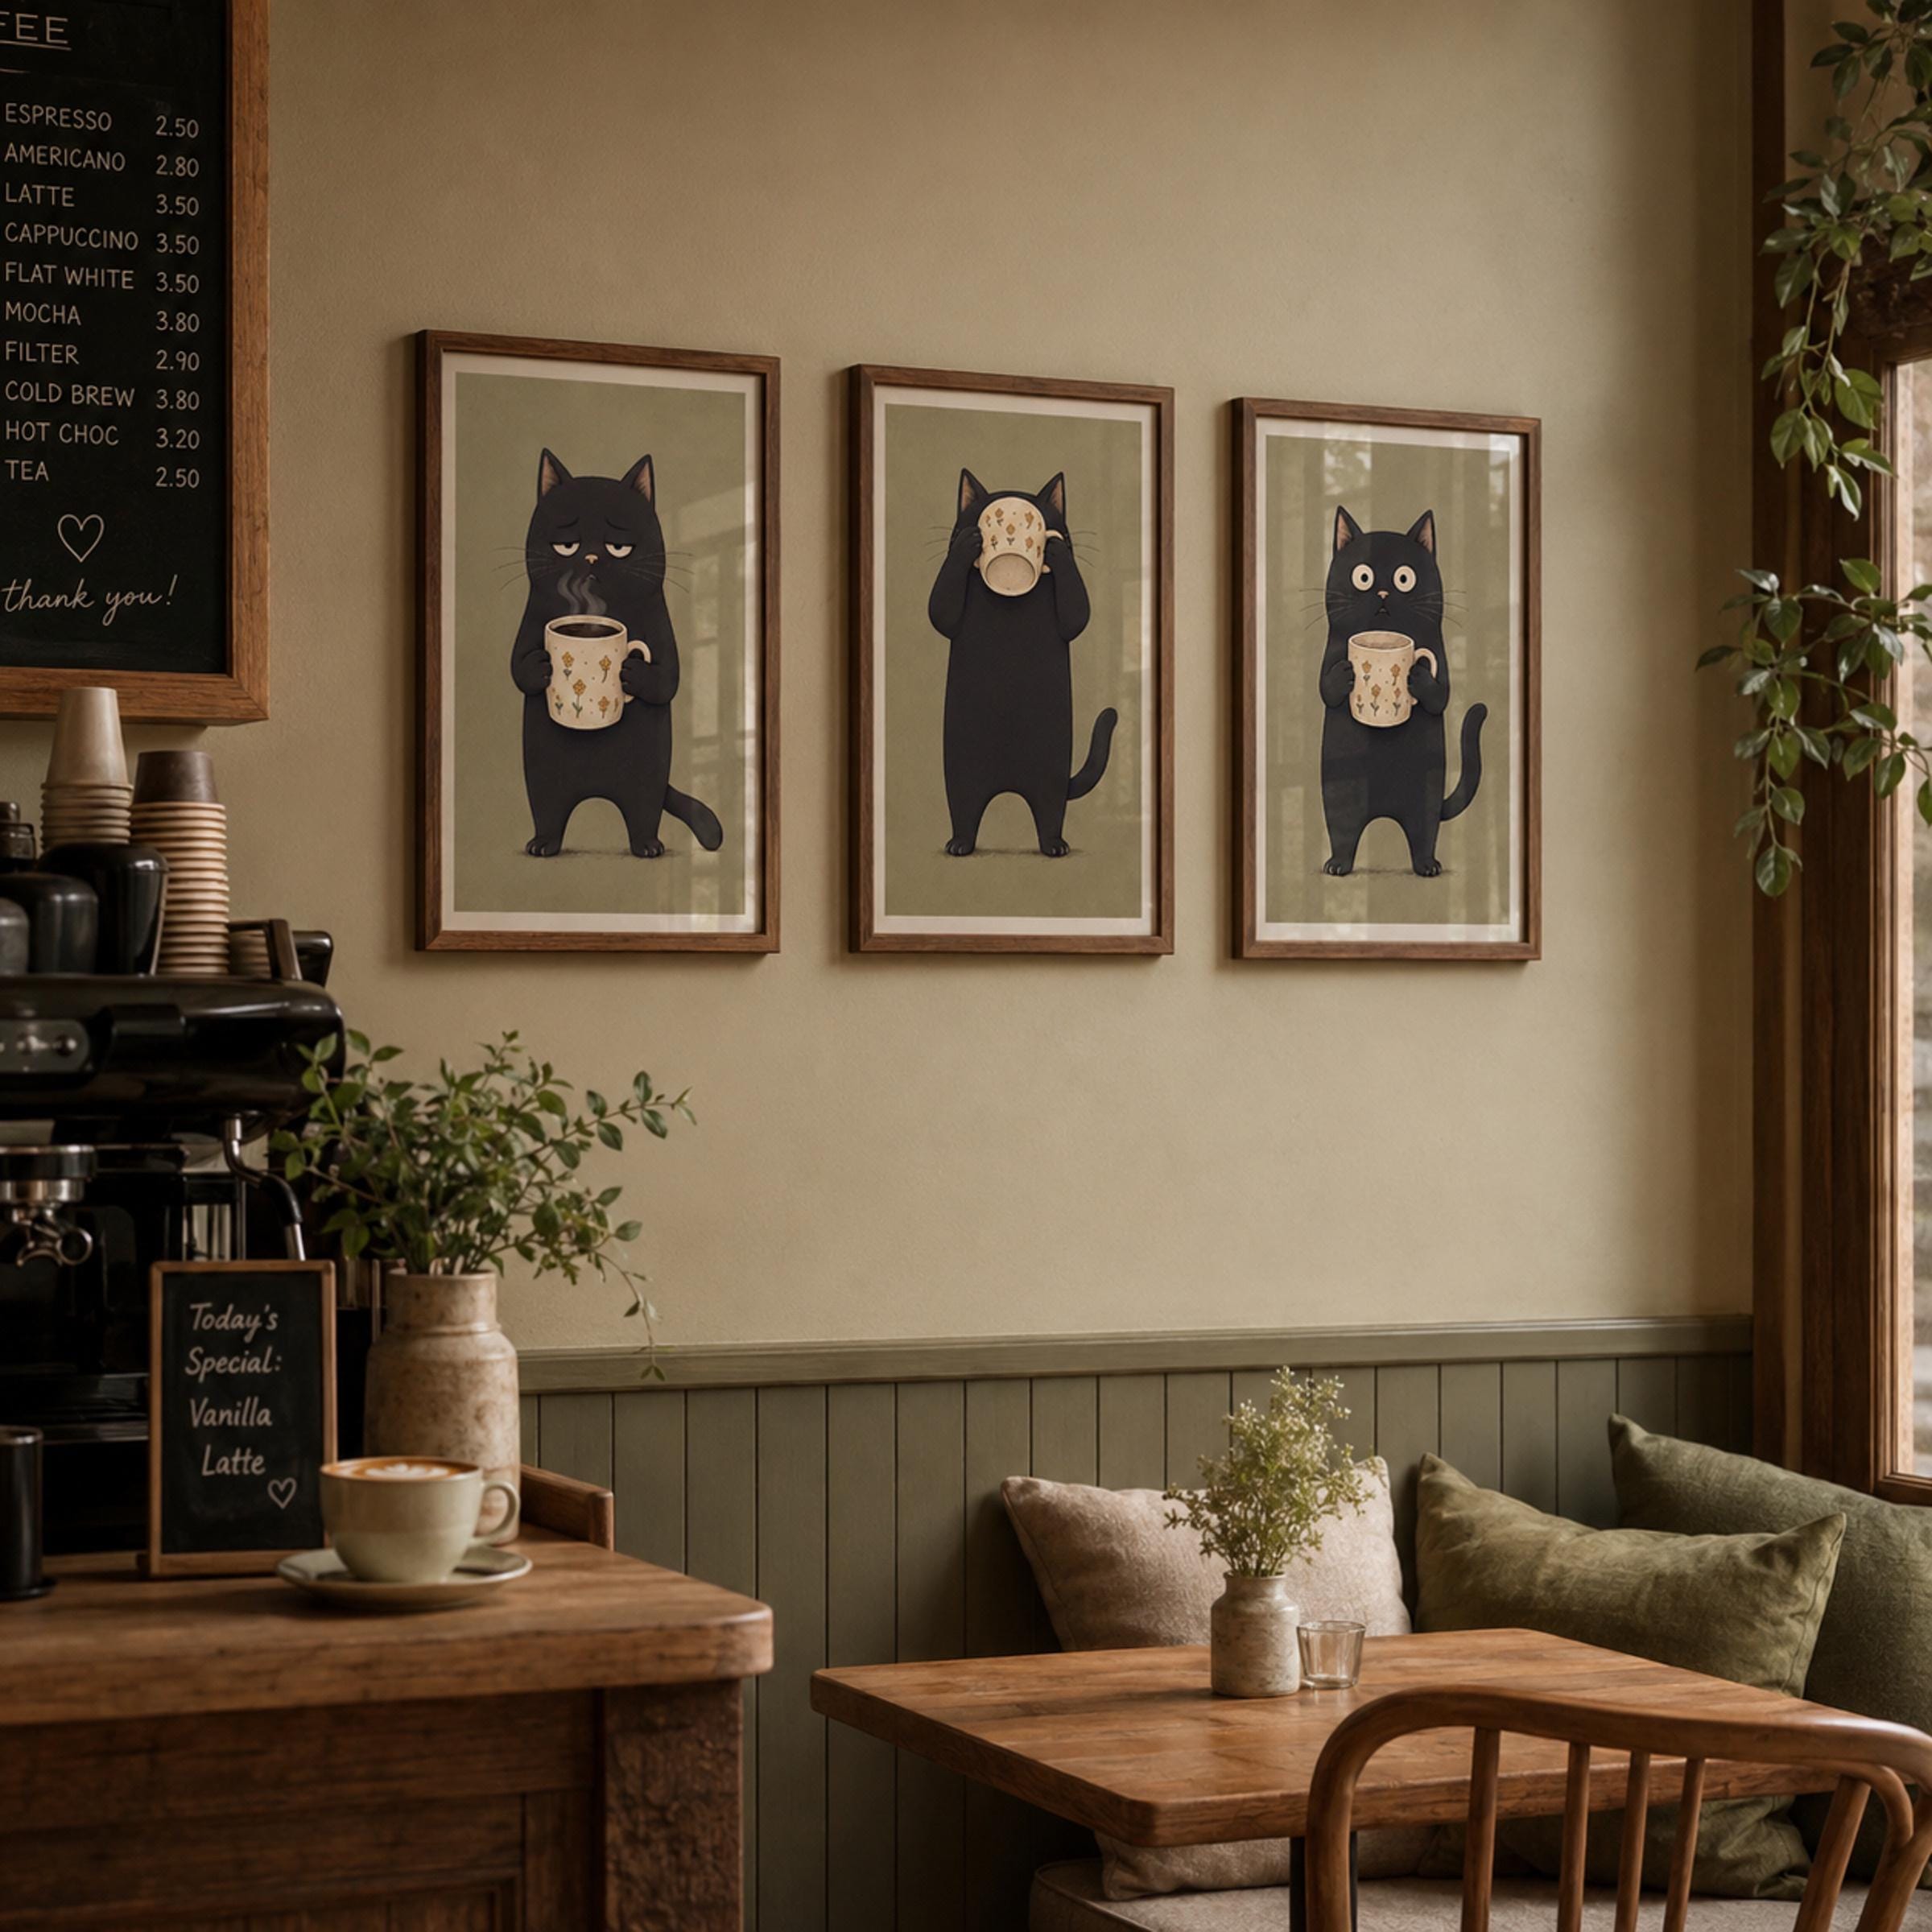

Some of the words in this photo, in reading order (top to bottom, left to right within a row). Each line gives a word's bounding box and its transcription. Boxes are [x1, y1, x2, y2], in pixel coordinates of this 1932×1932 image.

[6, 102, 112, 131] ESPRESSO
[155, 115, 199, 138] 2.50
[4, 142, 126, 171] AMERICANO
[156, 155, 199, 177] 2.80
[6, 183, 74, 207] LATTE
[156, 193, 199, 217] 3.50
[5, 222, 138, 250] CAPPUCCINO
[157, 233, 199, 255] 3.50
[6, 262, 57, 283] FLAT
[64, 266, 134, 289] WHITE
[156, 271, 200, 294] 3.50
[6, 301, 81, 325] MOCHA
[156, 310, 200, 332] 3.80
[6, 341, 80, 365] FILTER
[155, 349, 200, 371] 2.90
[5, 380, 62, 402] COLD
[72, 384, 135, 407] BREW
[156, 389, 200, 411] 3.80
[6, 420, 51, 441] HOT
[59, 423, 119, 446] CHOC
[156, 427, 200, 450] 3.20
[5, 460, 49, 481] TEA
[155, 466, 200, 489] 2.50
[2, 578, 94, 613] thank
[102, 574, 178, 626] you!
[190, 1302, 279, 1343] Today's
[184, 1346, 282, 1383] Special:
[190, 1397, 273, 1427] Vanilla
[201, 1444, 266, 1476] Latte
